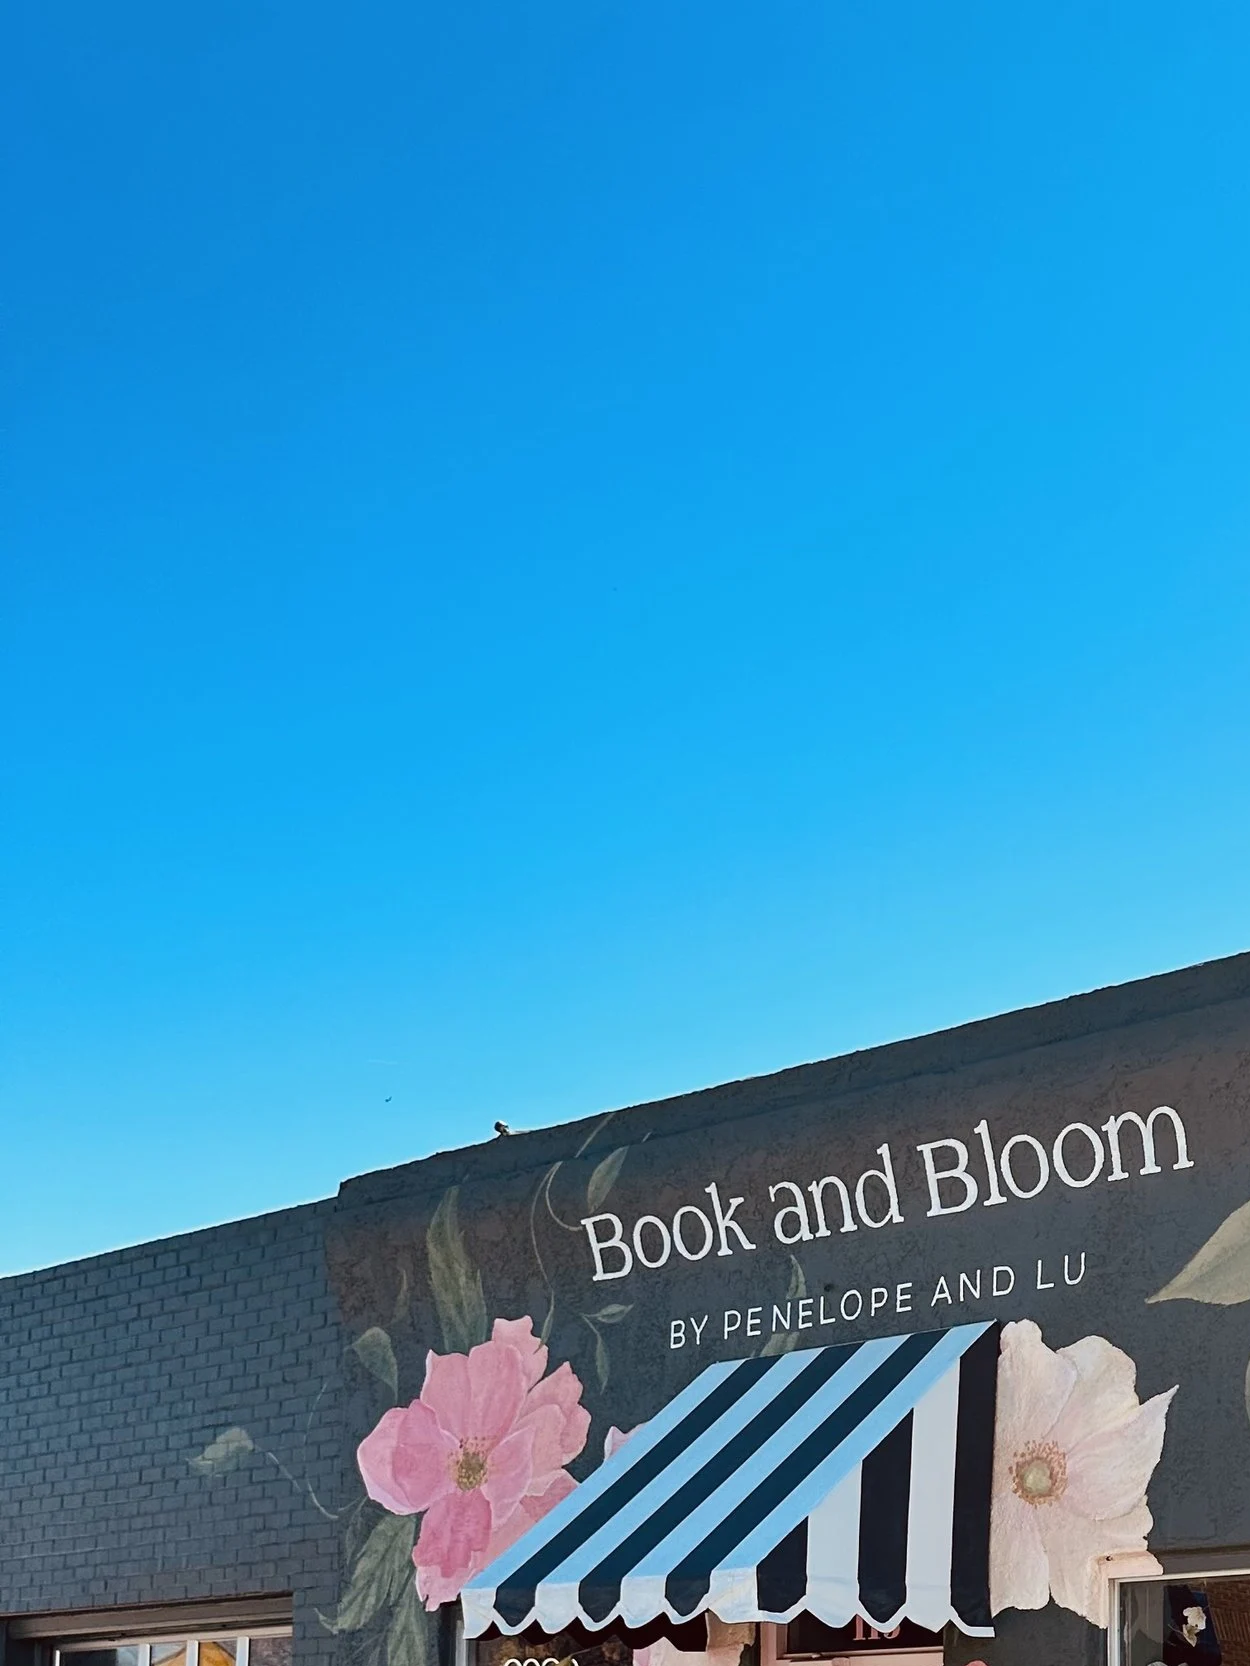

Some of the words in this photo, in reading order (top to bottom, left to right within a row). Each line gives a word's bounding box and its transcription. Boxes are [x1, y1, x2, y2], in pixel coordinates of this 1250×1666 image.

[580, 1181, 757, 1282] Book
[768, 1143, 906, 1246] and
[916, 1105, 1194, 1218] Bloom
[669, 1314, 708, 1349] BY
[723, 1282, 913, 1340] PENELOPE
[931, 1264, 1015, 1308] AND
[1036, 1252, 1087, 1290] LU
